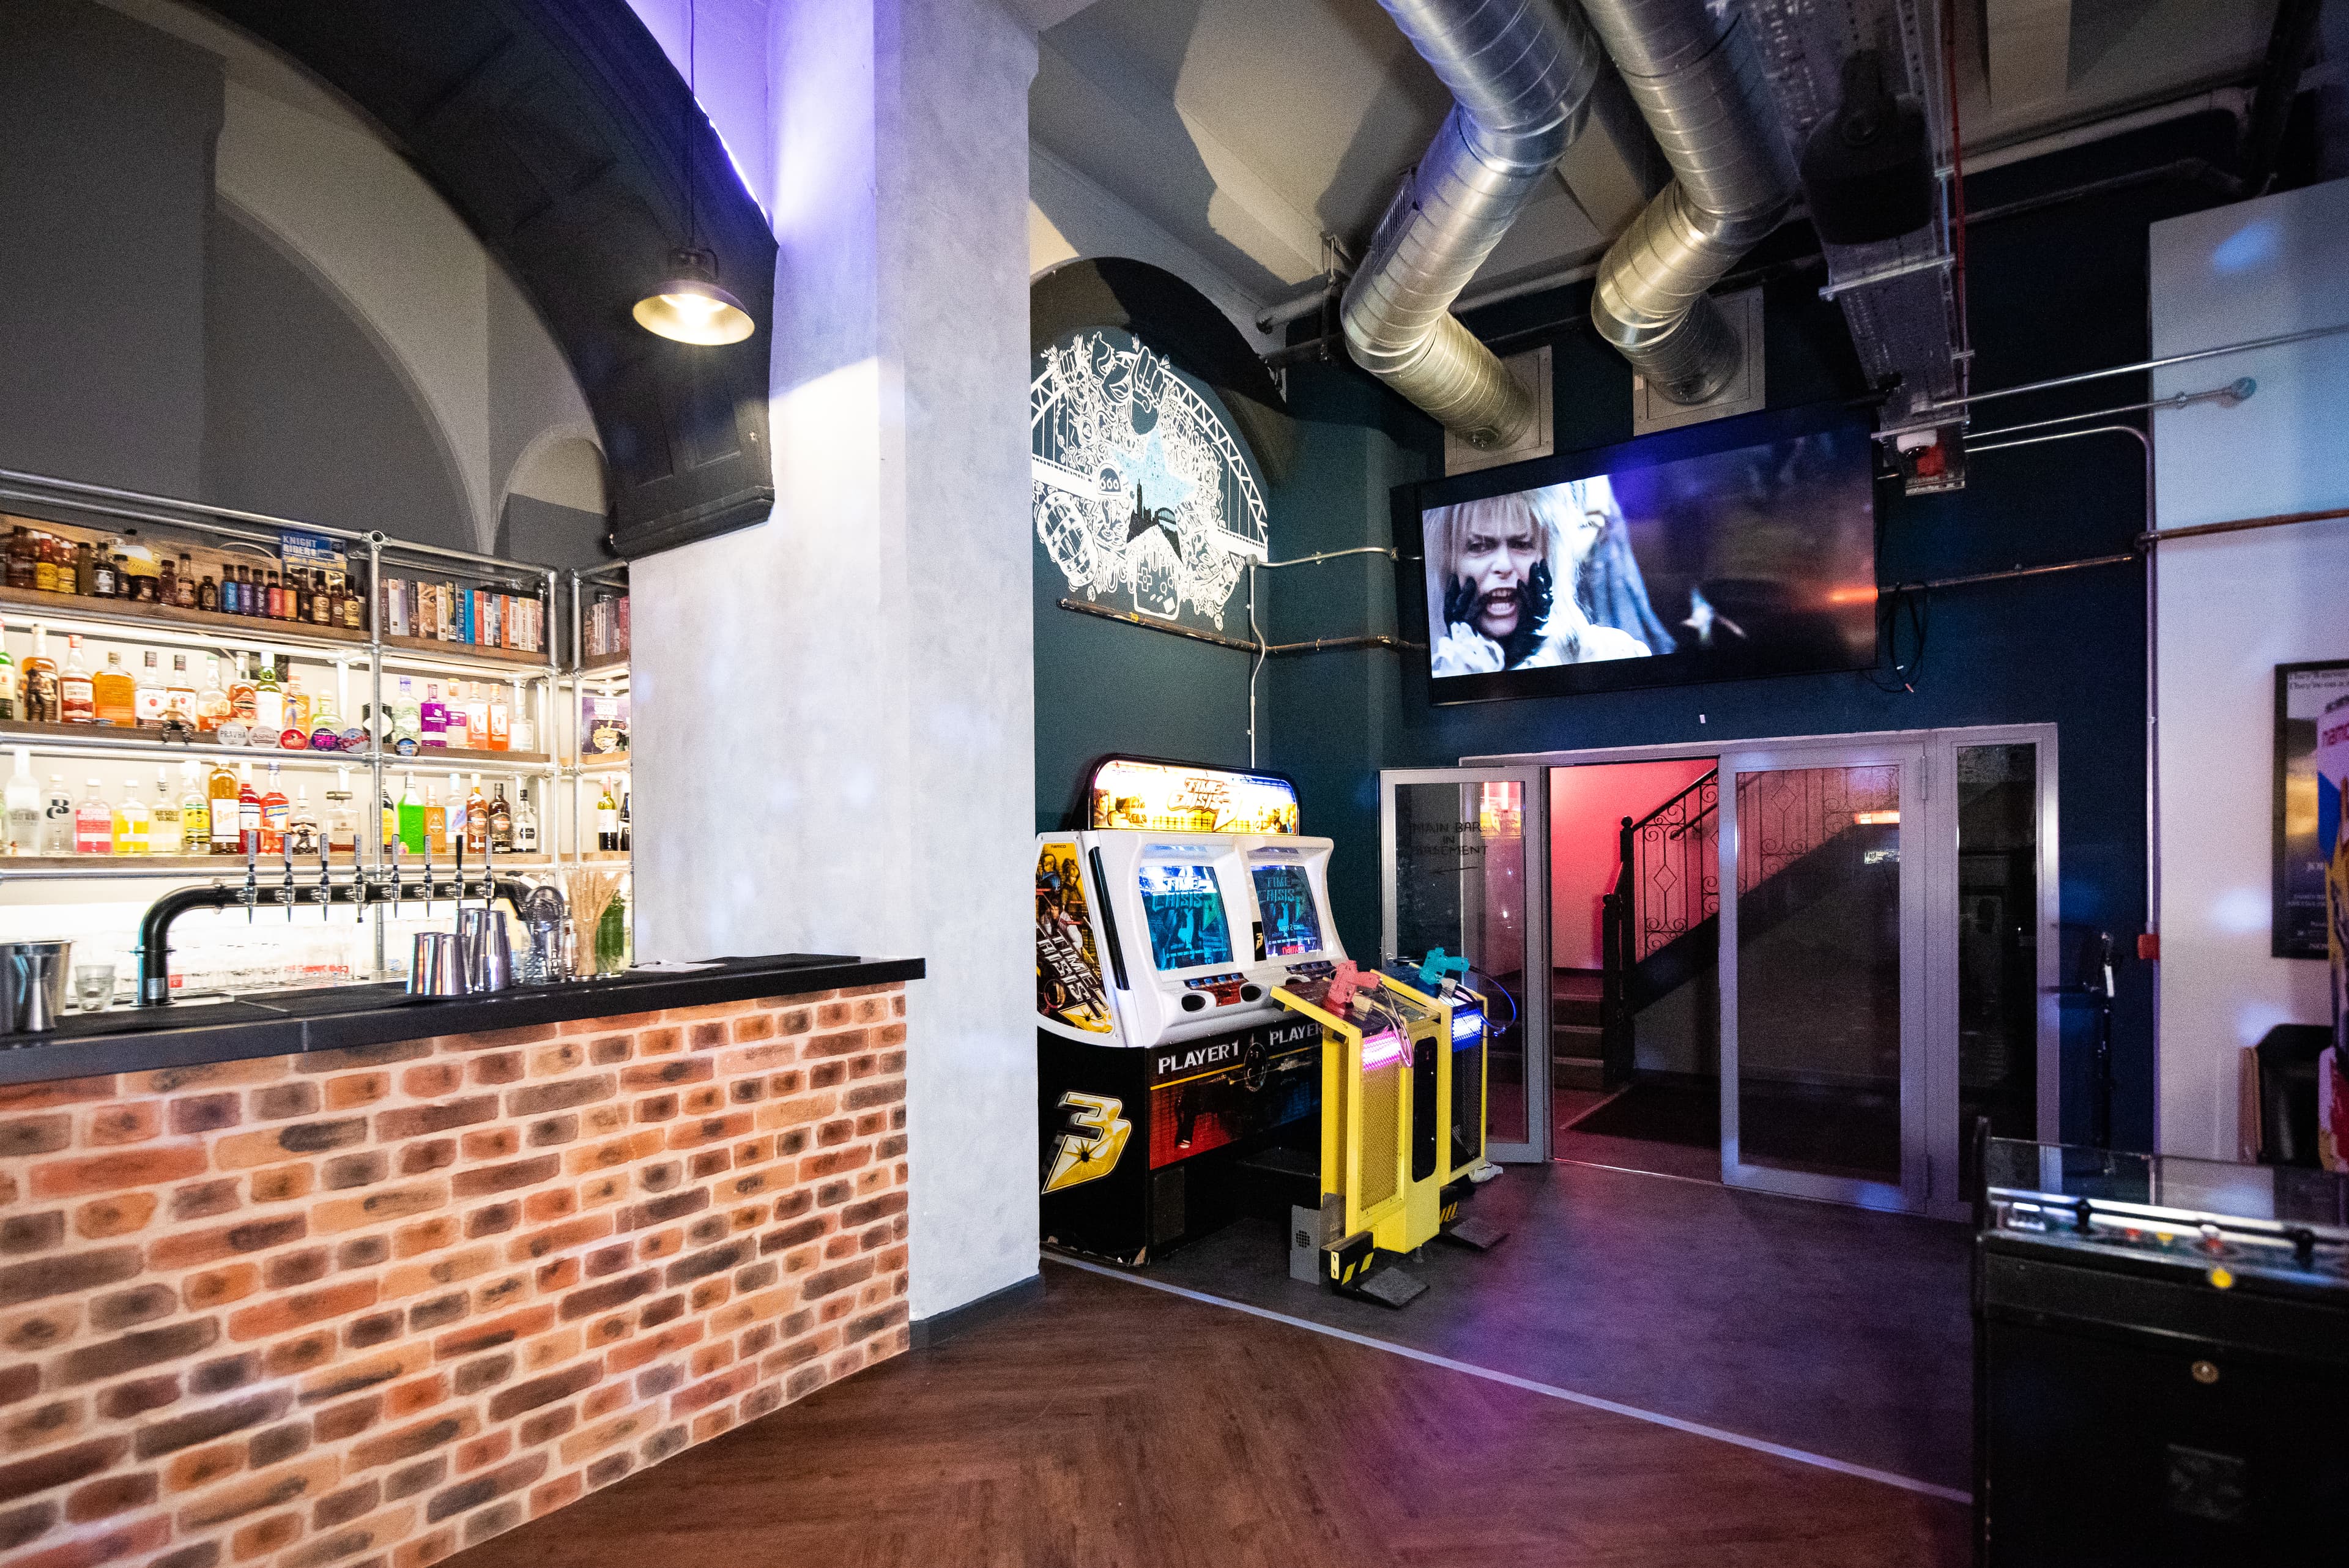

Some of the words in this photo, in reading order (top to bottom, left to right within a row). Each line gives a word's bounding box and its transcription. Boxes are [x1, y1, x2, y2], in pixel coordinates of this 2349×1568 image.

[1100, 477, 1119, 490] 666
[283, 535, 317, 549] KNIGHT
[1184, 778, 1223, 794] TIME
[1167, 790, 1223, 812] CRISIS
[1409, 822, 1449, 833] MAIN
[1455, 822, 1482, 833] BAR
[1444, 835, 1455, 844] IN
[1417, 845, 1488, 855] BASEMENT
[1163, 877, 1198, 891] TIME
[1265, 876, 1291, 888] TIME
[1152, 891, 1203, 912] CRISIS
[1282, 945, 1305, 954] namco
[1037, 923, 1091, 1002] RISIS
[1052, 929, 1099, 989] TIME
[1158, 1043, 1230, 1075] PLAYER
[1232, 1040, 1239, 1057] 1
